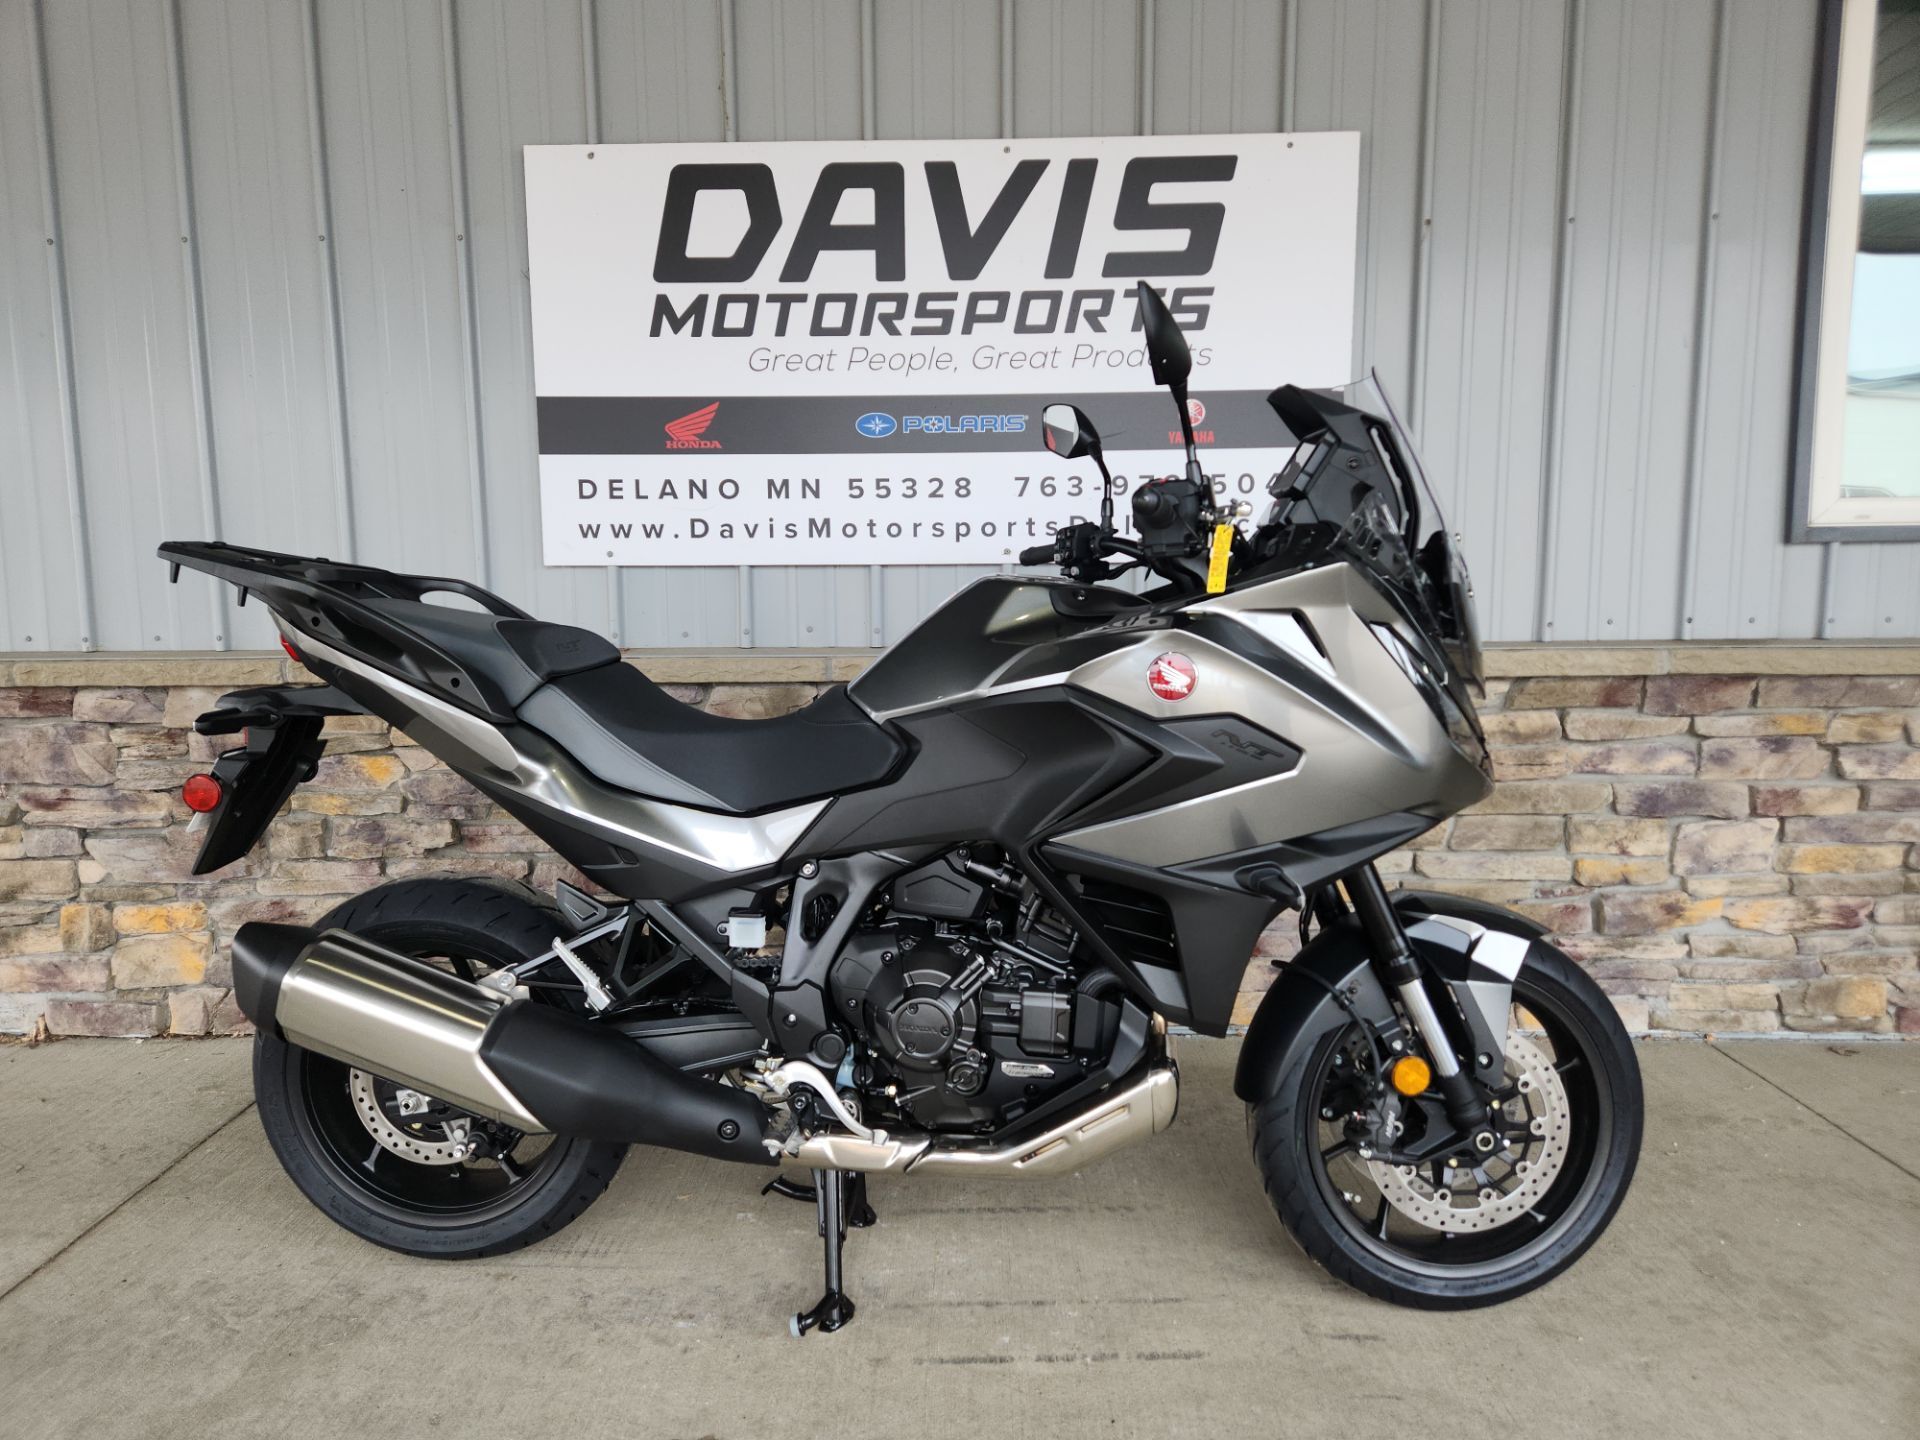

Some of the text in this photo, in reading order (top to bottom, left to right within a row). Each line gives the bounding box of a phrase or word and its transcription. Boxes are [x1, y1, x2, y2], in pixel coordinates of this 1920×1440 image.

[653, 155, 1238, 283] DAVIS
[649, 287, 1215, 338] MOTORSPORTS
[749, 342, 1213, 377] Great People, Great Prods
[903, 414, 1026, 433] POLARIS
[665, 440, 722, 449] HONDA
[1168, 431, 1215, 444] YAAHA
[578, 478, 740, 500] DELANO
[767, 478, 820, 499] MN
[848, 477, 971, 499] 55328
